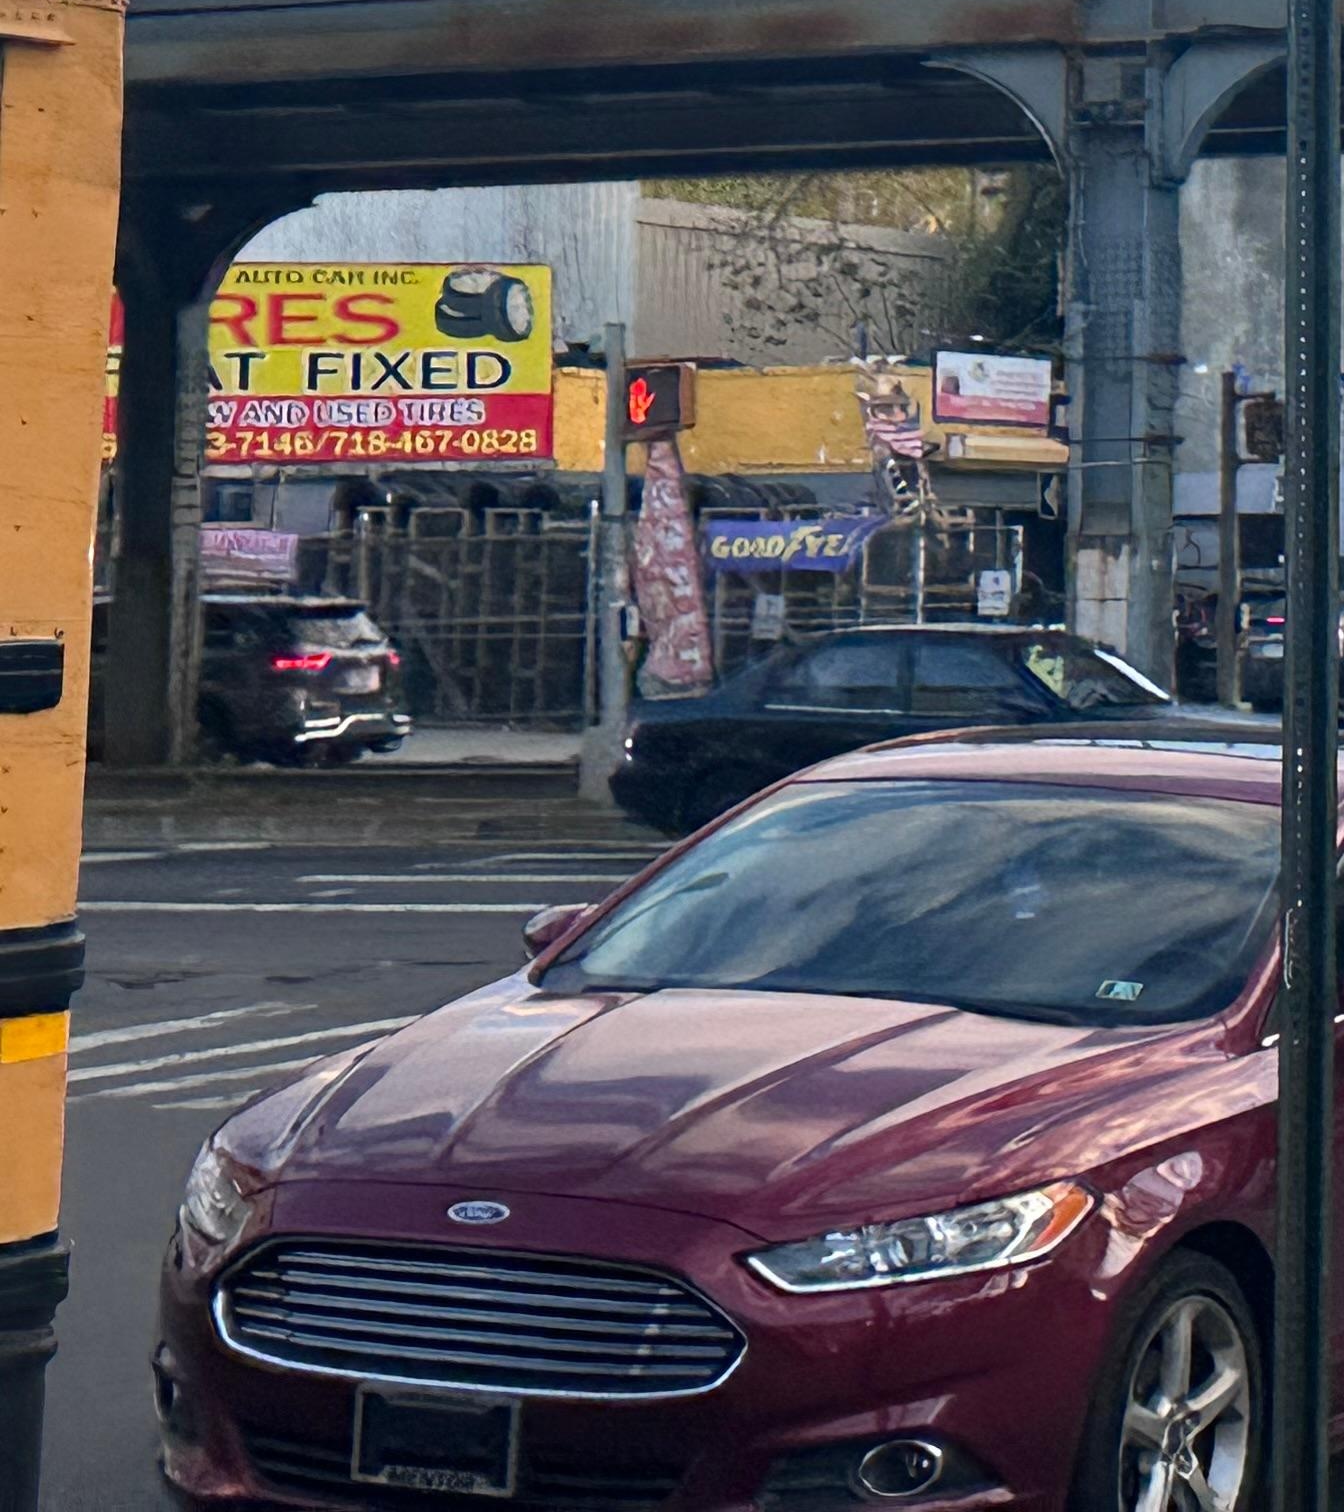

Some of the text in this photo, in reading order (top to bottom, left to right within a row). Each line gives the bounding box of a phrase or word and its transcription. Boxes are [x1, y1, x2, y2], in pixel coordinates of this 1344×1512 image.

[235, 270, 304, 285] AUTO
[211, 293, 400, 346] RES
[307, 350, 513, 391] FIXED
[241, 400, 308, 425] AND
[315, 400, 396, 425] USED
[401, 399, 486, 425] TIRES
